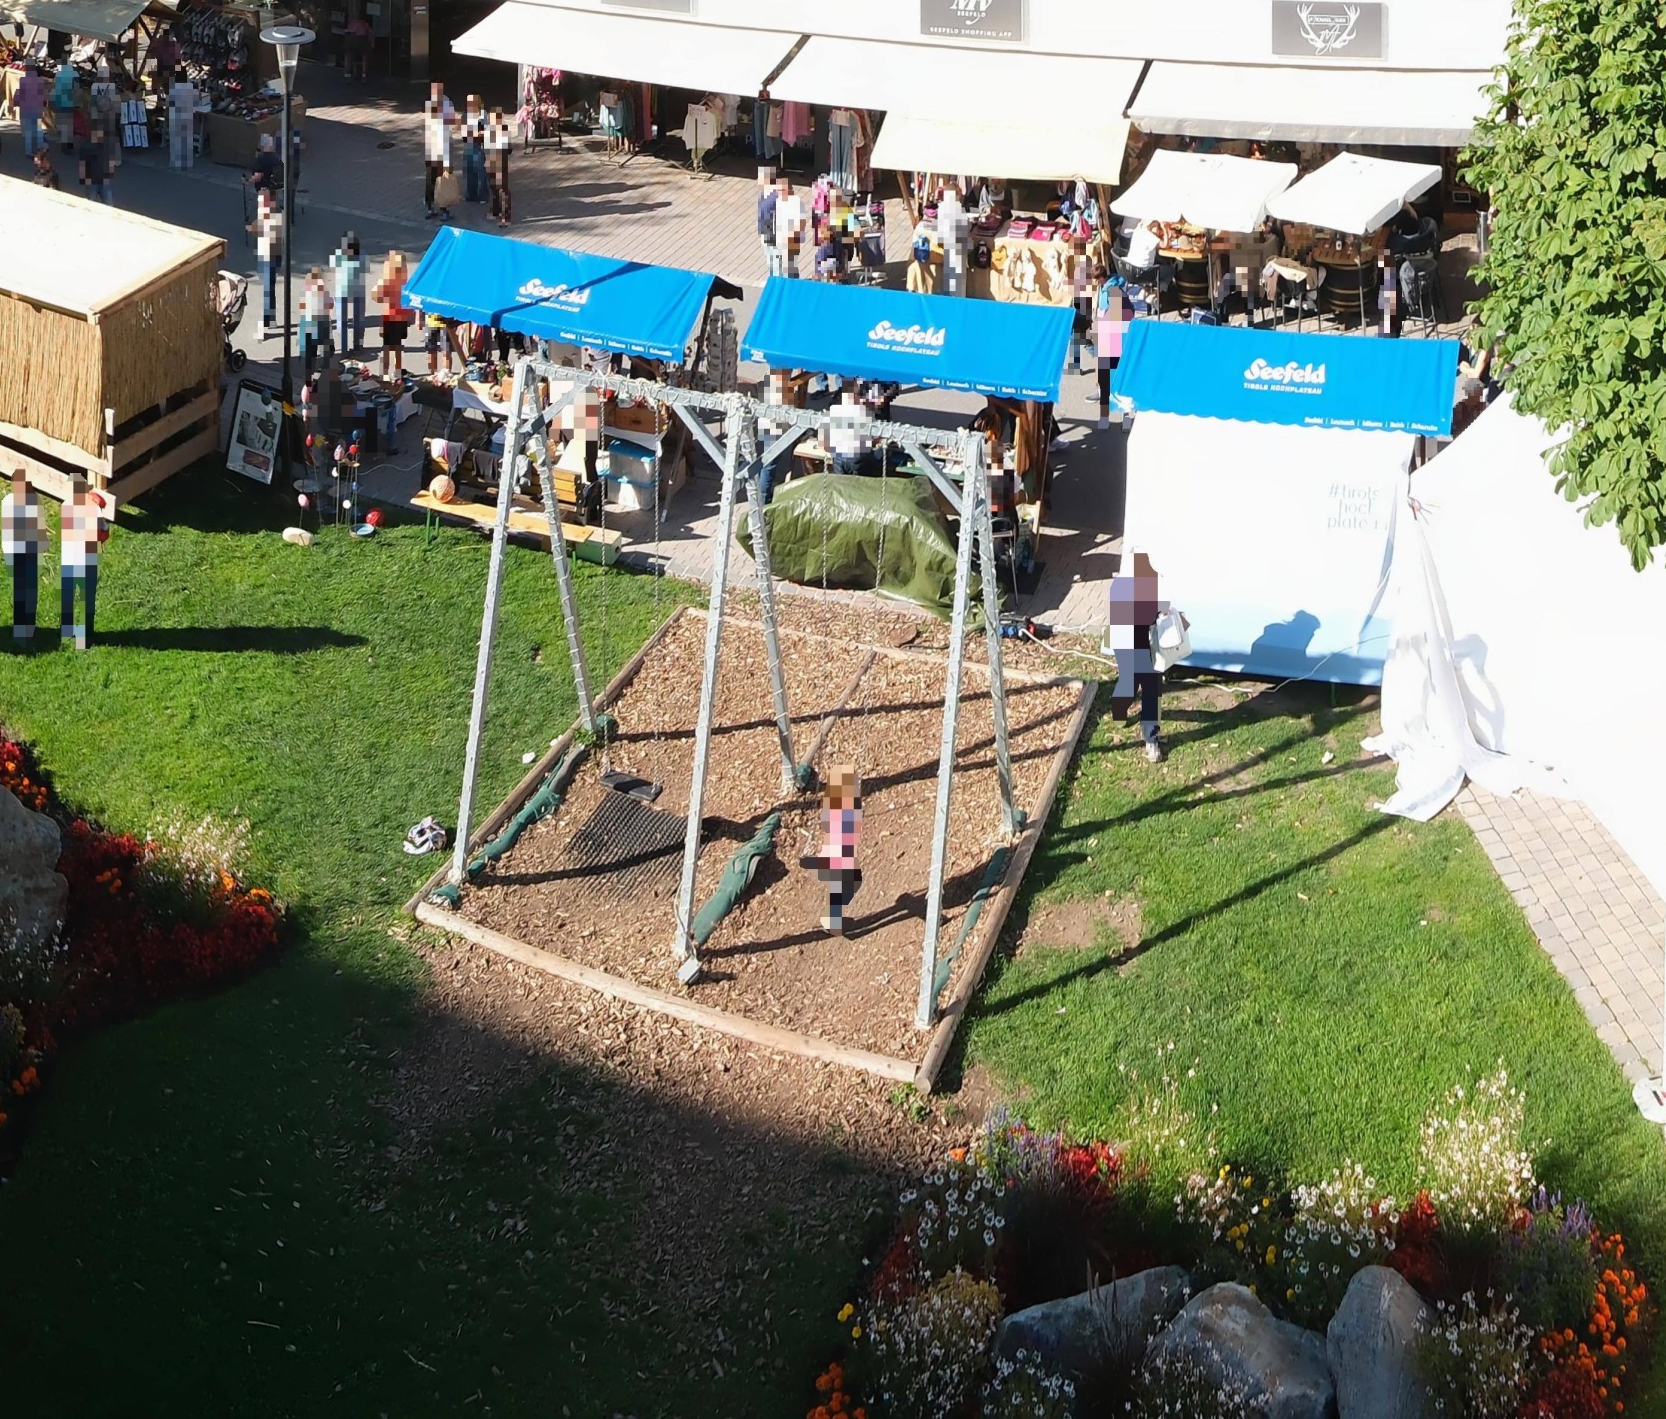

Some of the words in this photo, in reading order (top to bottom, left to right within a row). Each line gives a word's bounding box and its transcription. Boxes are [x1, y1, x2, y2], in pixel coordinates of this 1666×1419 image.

[930, 26, 959, 34] SEEFELD
[961, 28, 996, 36] SHOPPING
[519, 278, 590, 304] Seefeld
[868, 320, 946, 346] Seefeld
[1243, 357, 1326, 385] Seefeld
